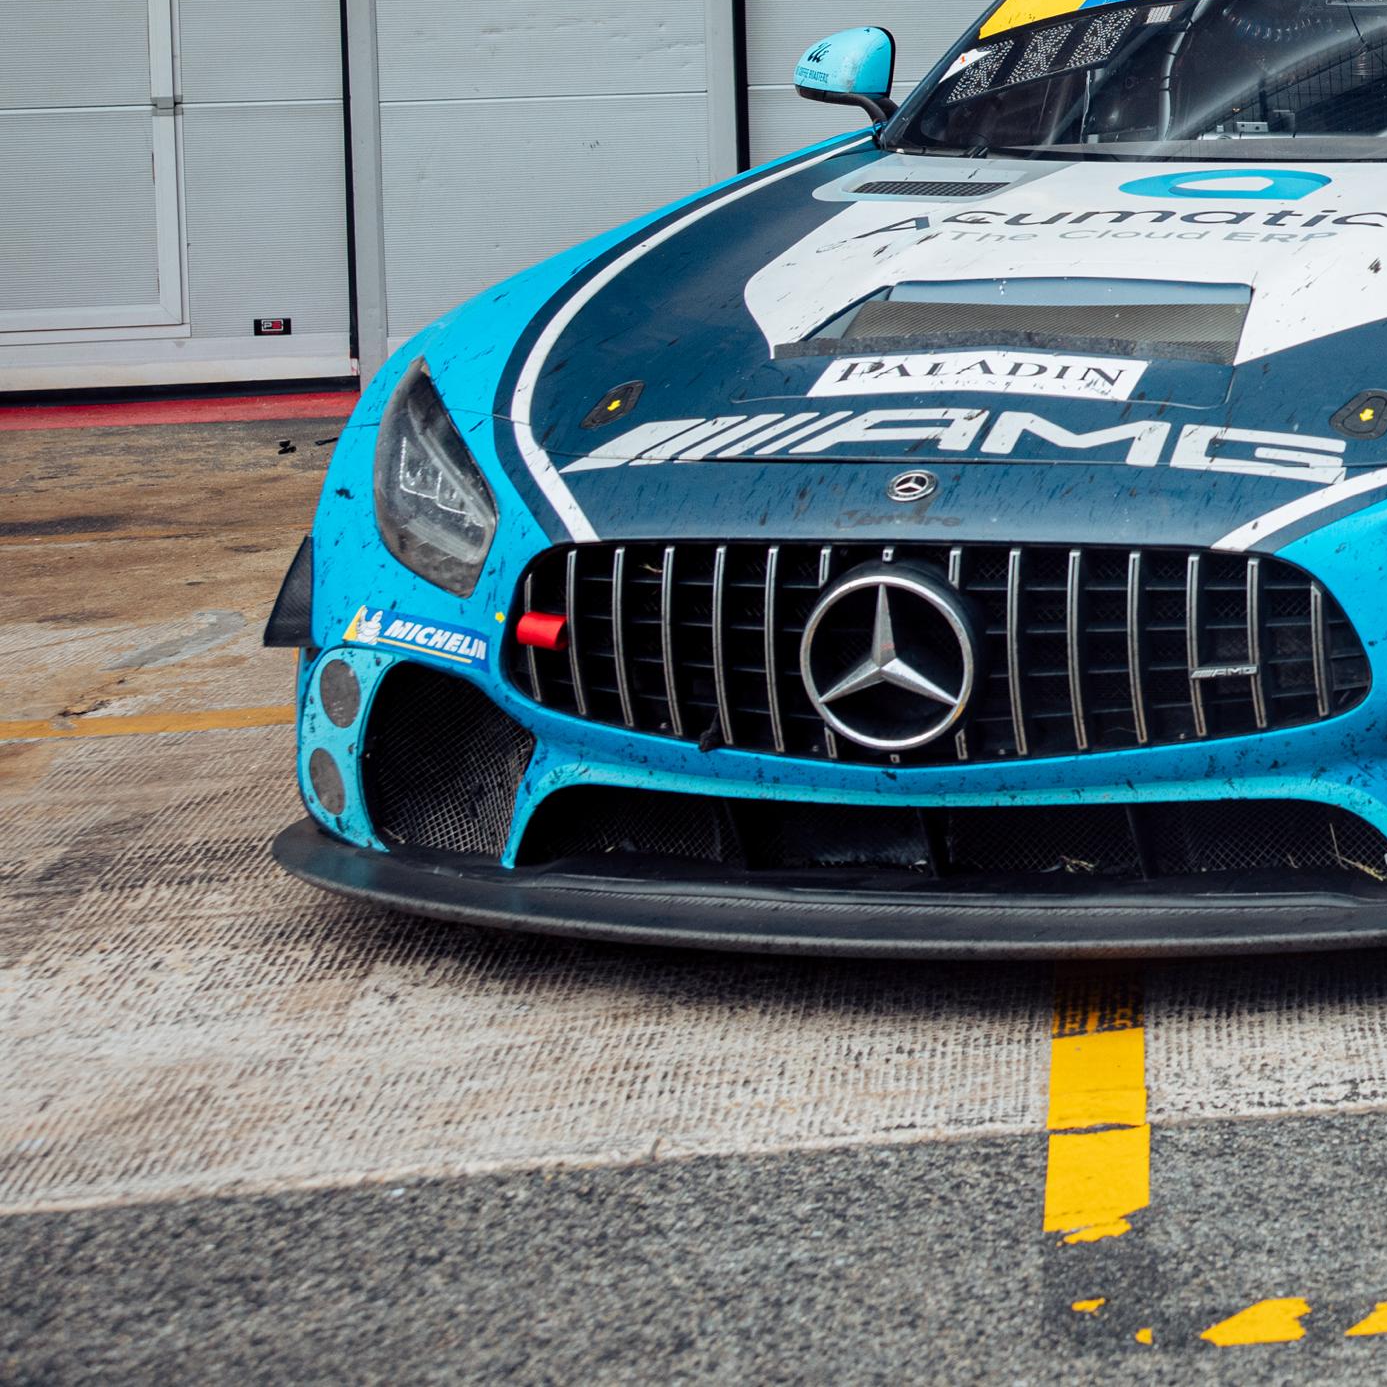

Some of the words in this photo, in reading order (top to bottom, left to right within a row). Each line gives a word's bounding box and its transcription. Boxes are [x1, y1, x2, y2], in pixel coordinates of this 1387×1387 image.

[940, 230, 1039, 244] The
[1056, 229, 1211, 243] Cloud
[1220, 230, 1339, 244] ERP
[834, 359, 1128, 388] PALADIN
[384, 618, 487, 661] MICHELIN
